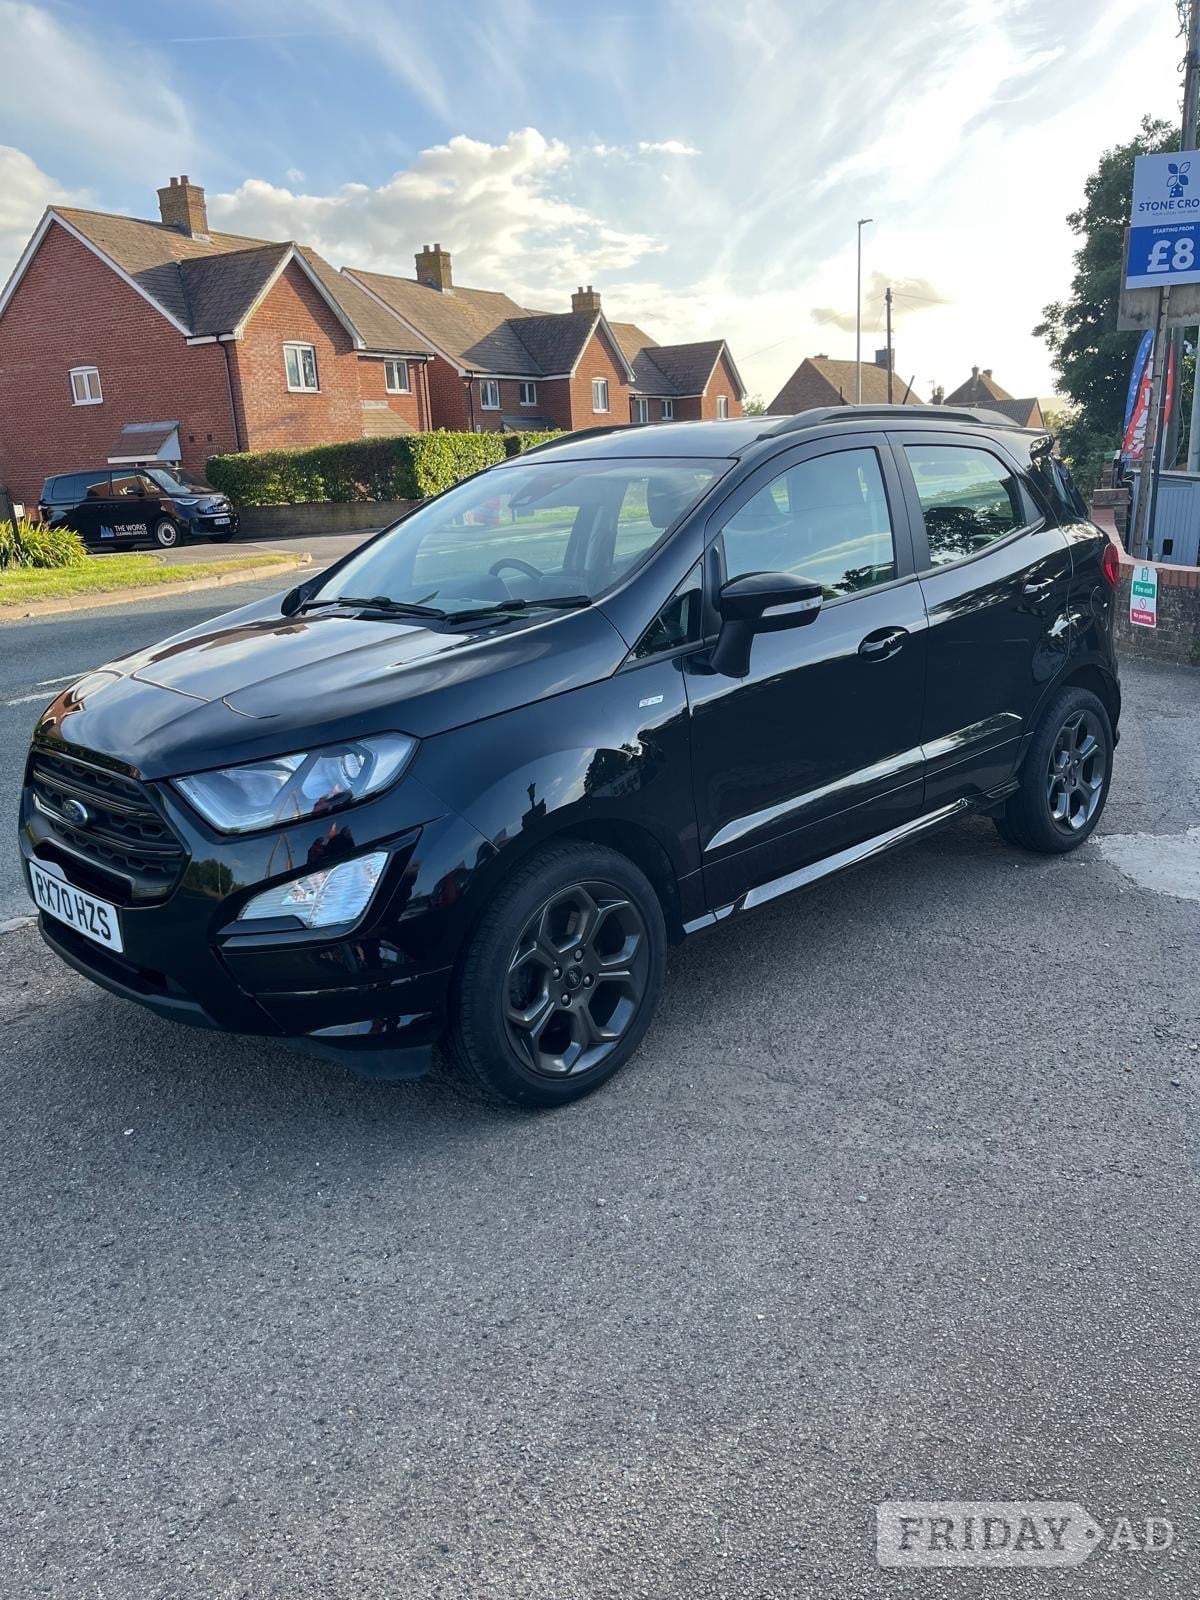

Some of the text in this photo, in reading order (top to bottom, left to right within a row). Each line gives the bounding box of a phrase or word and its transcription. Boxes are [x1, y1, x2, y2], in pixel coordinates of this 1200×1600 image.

[1139, 199, 1200, 211] STONE CRO
[1147, 238, 1194, 272] £8
[114, 523, 147, 532] THE WORKS
[1138, 614, 1152, 622] parking
[35, 871, 112, 941] RX70 HZS
